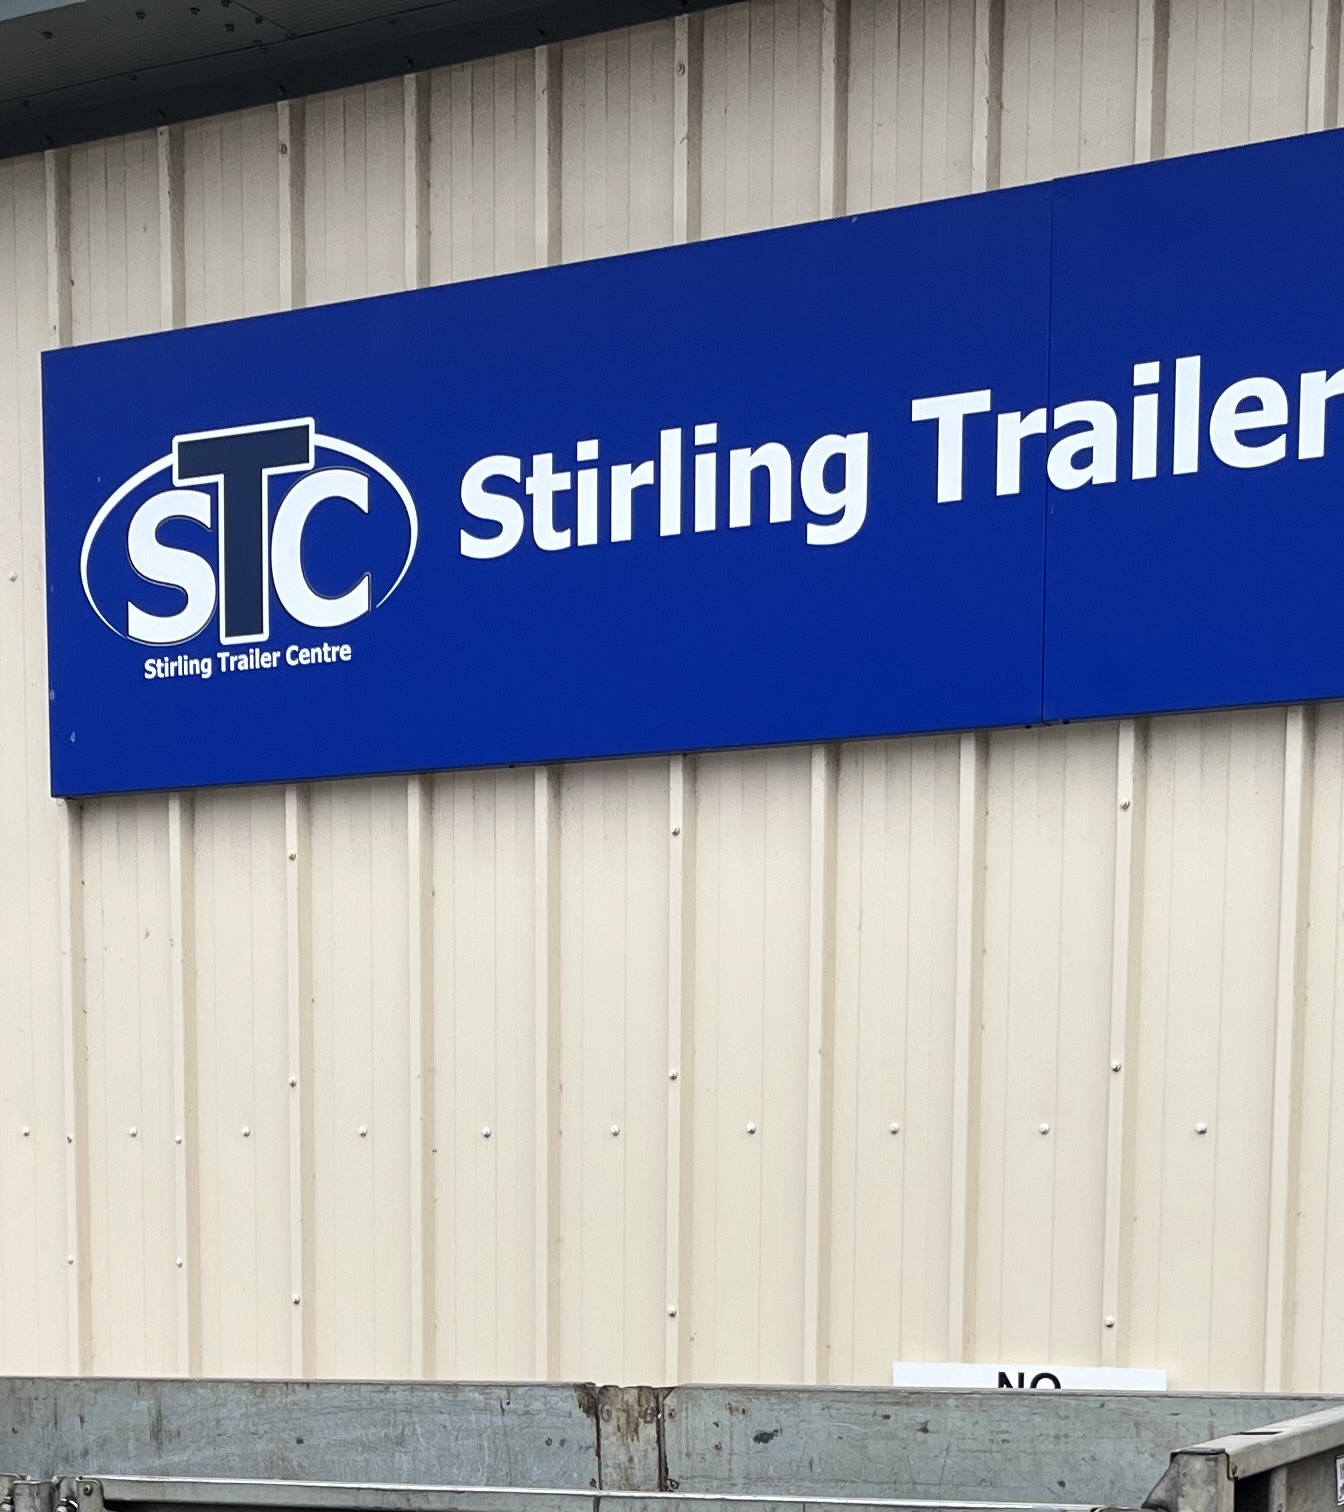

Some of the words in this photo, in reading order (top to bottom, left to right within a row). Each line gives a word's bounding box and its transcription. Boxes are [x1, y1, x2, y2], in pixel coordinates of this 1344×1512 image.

[126, 416, 371, 646] STC
[459, 422, 869, 560] Stirling
[144, 654, 213, 679] Stirling
[217, 648, 281, 673] Trailer
[285, 641, 353, 666] Centre
